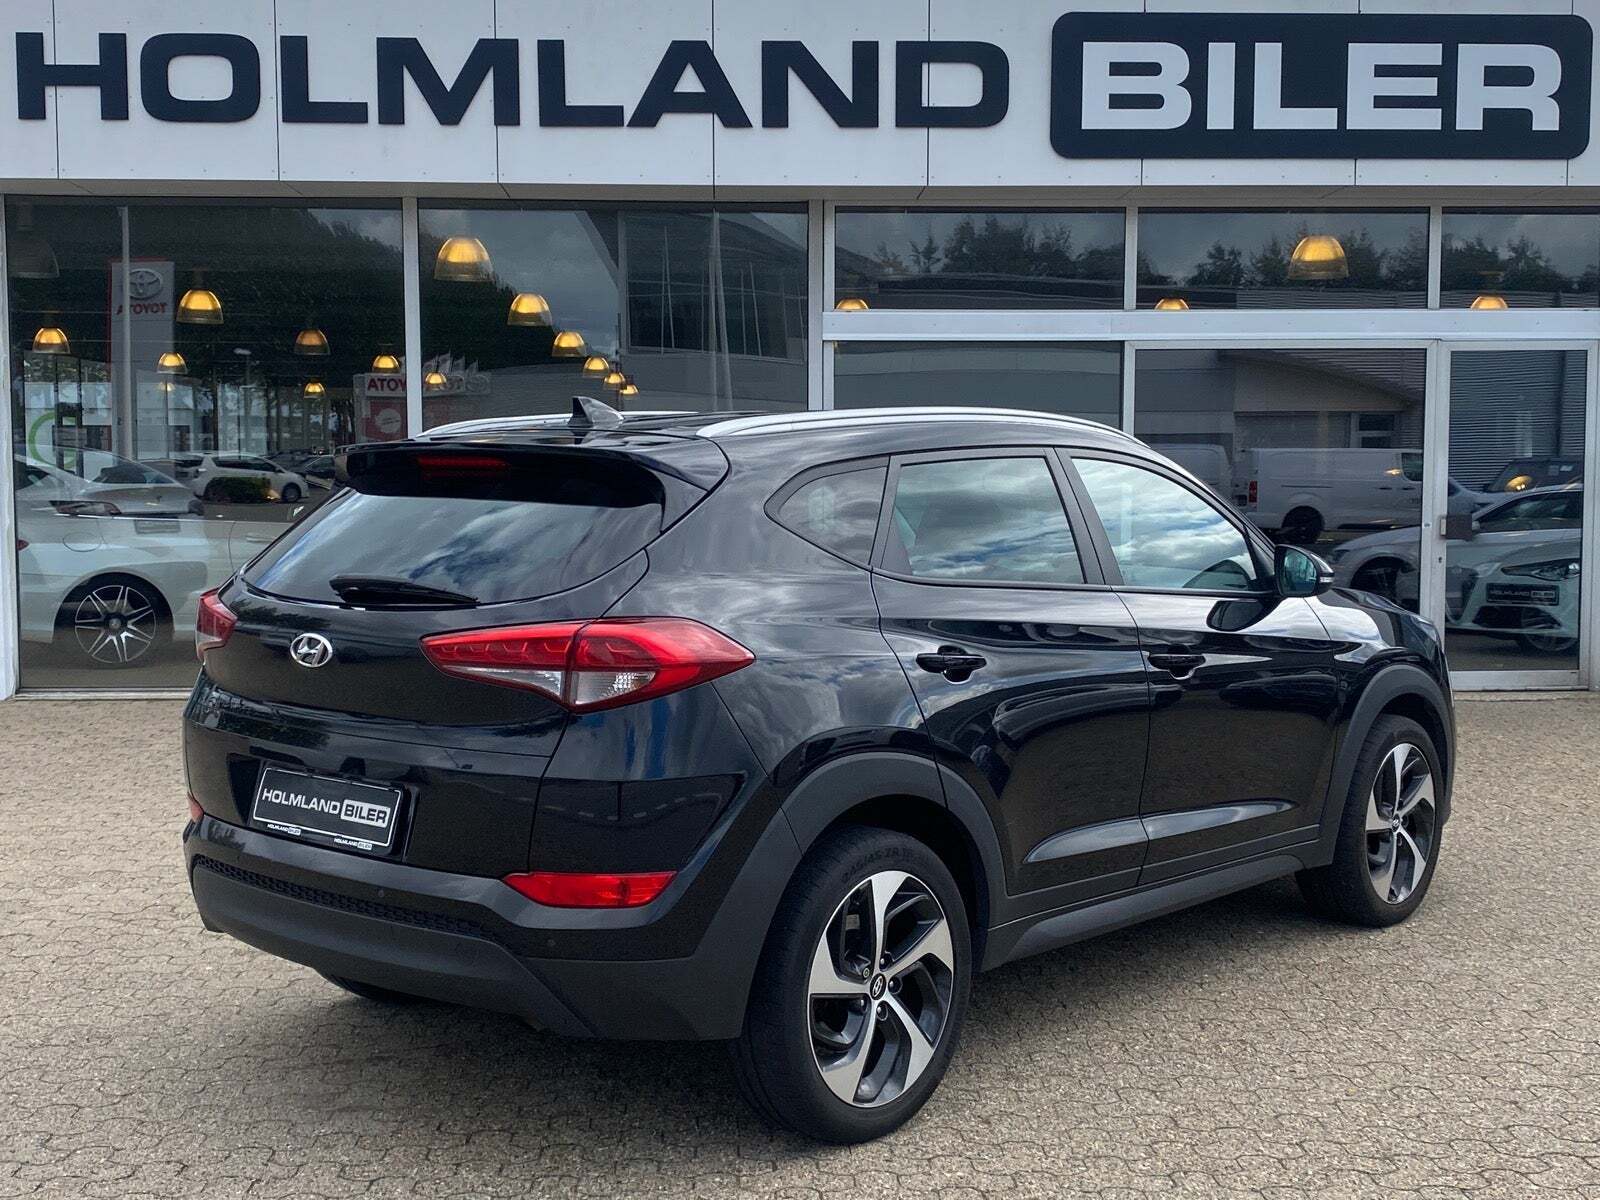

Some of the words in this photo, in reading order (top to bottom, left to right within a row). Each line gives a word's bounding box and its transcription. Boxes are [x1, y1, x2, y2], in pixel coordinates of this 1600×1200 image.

[16, 32, 1010, 128] HOLMLAND
[1081, 41, 1562, 131] BILER
[262, 788, 341, 815] HOLMLAND
[343, 804, 388, 824] BILER
